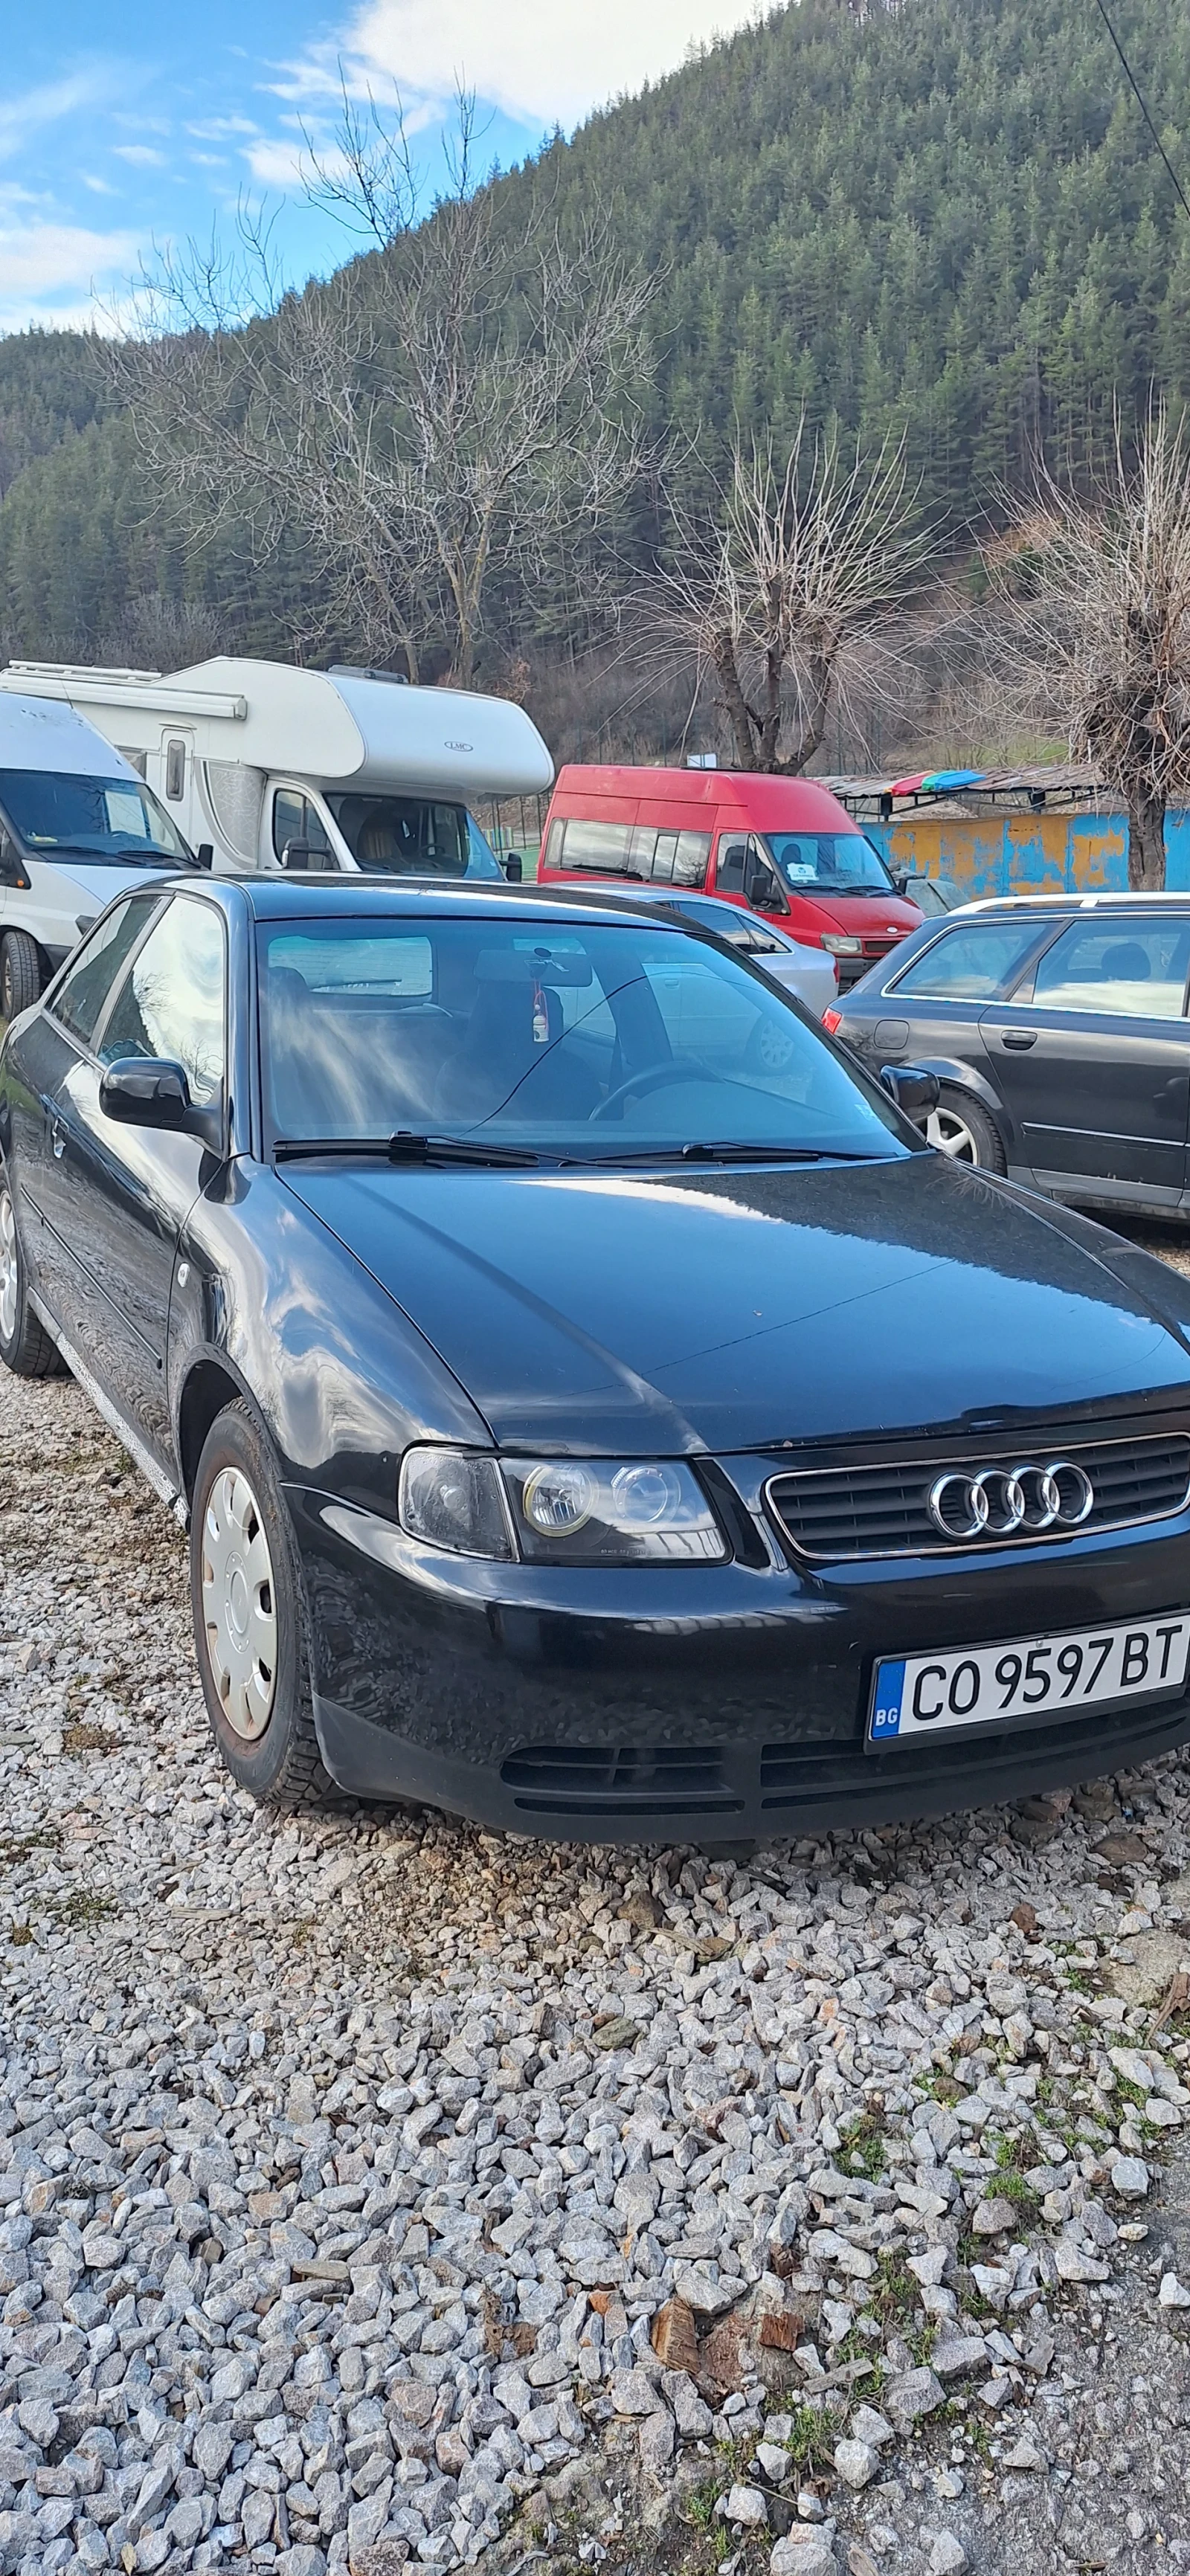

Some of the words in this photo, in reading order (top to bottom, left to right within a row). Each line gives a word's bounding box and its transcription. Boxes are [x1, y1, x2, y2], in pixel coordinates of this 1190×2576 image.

[450, 741, 467, 750] LMC
[913, 1660, 980, 1721] CO
[995, 1638, 1114, 1709] 9597
[1119, 1625, 1183, 1687] BT
[875, 1707, 898, 1727] BG
